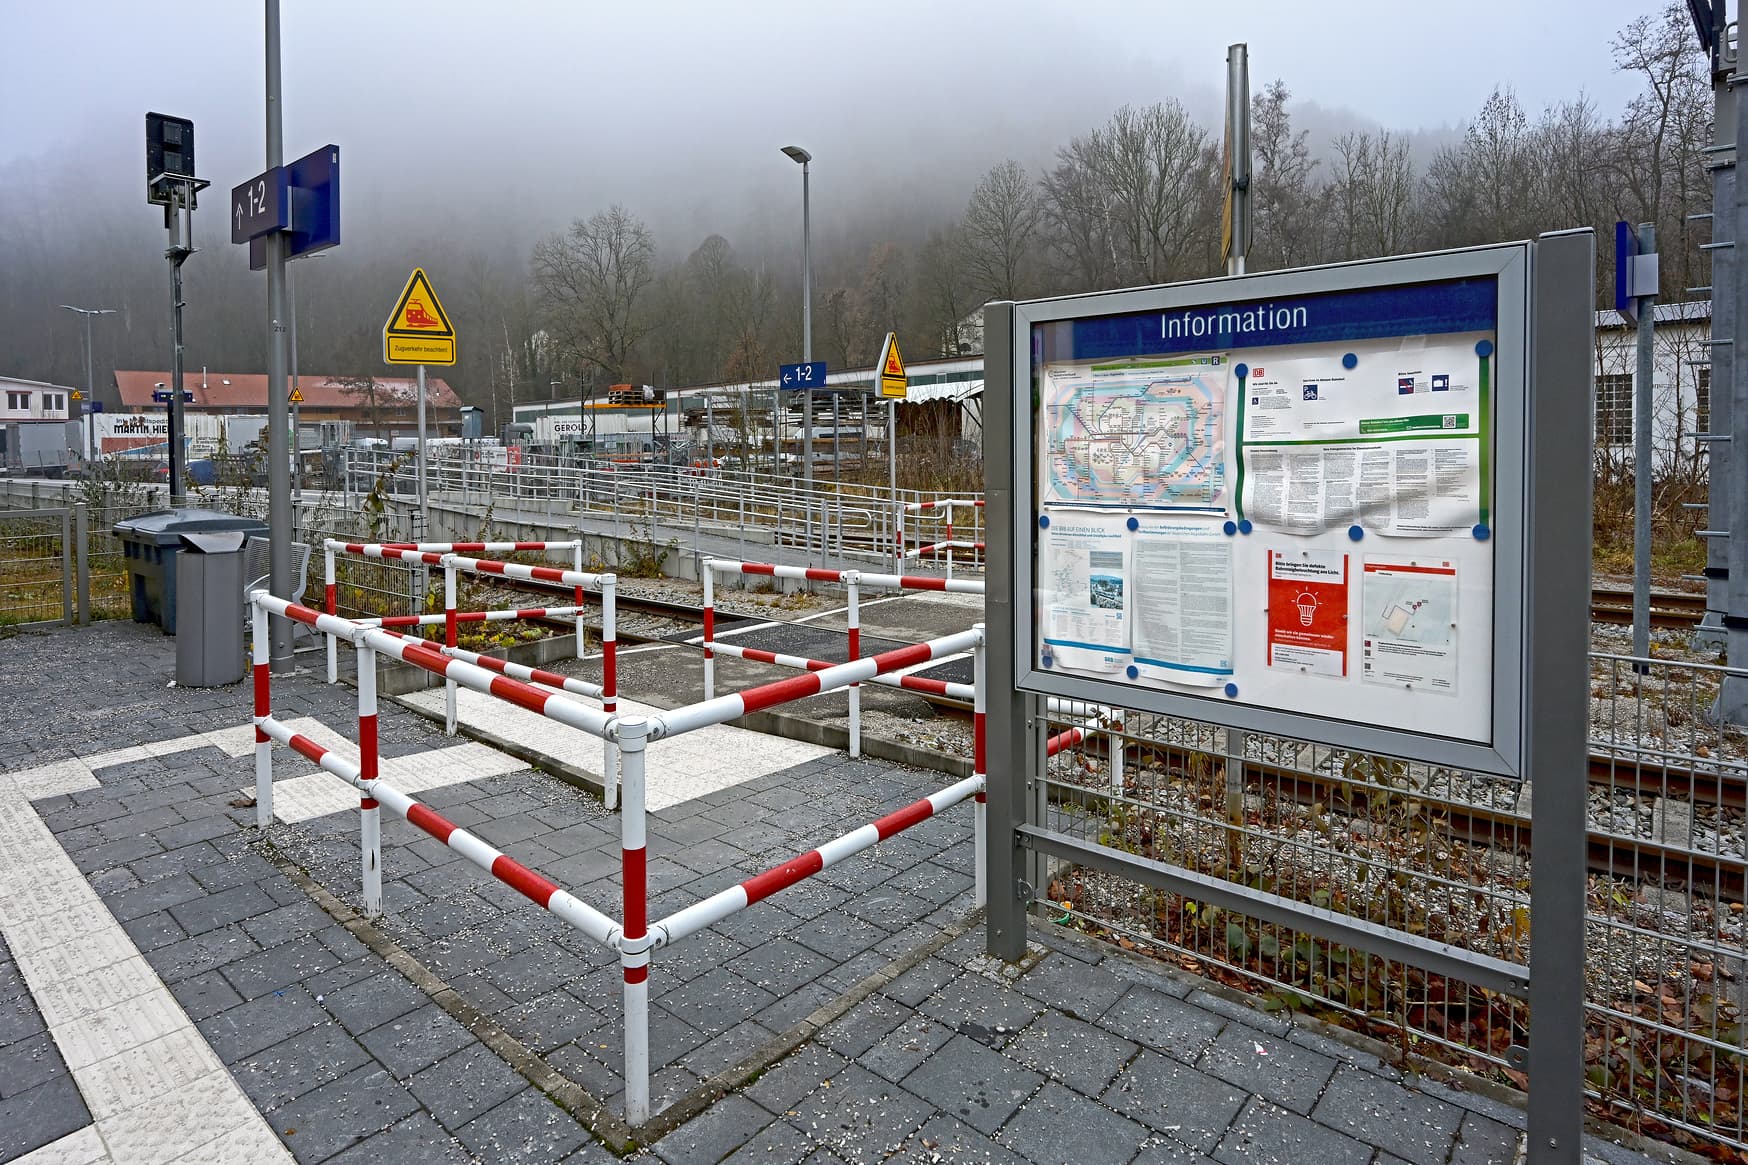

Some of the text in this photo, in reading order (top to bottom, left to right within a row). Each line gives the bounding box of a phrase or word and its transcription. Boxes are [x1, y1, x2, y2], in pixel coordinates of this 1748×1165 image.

[247, 180, 266, 217] 1-2
[1161, 303, 1307, 339] Information
[795, 365, 812, 382] 1-2
[113, 424, 168, 434] MARTIN HIE
[554, 424, 588, 432] GEROLD
